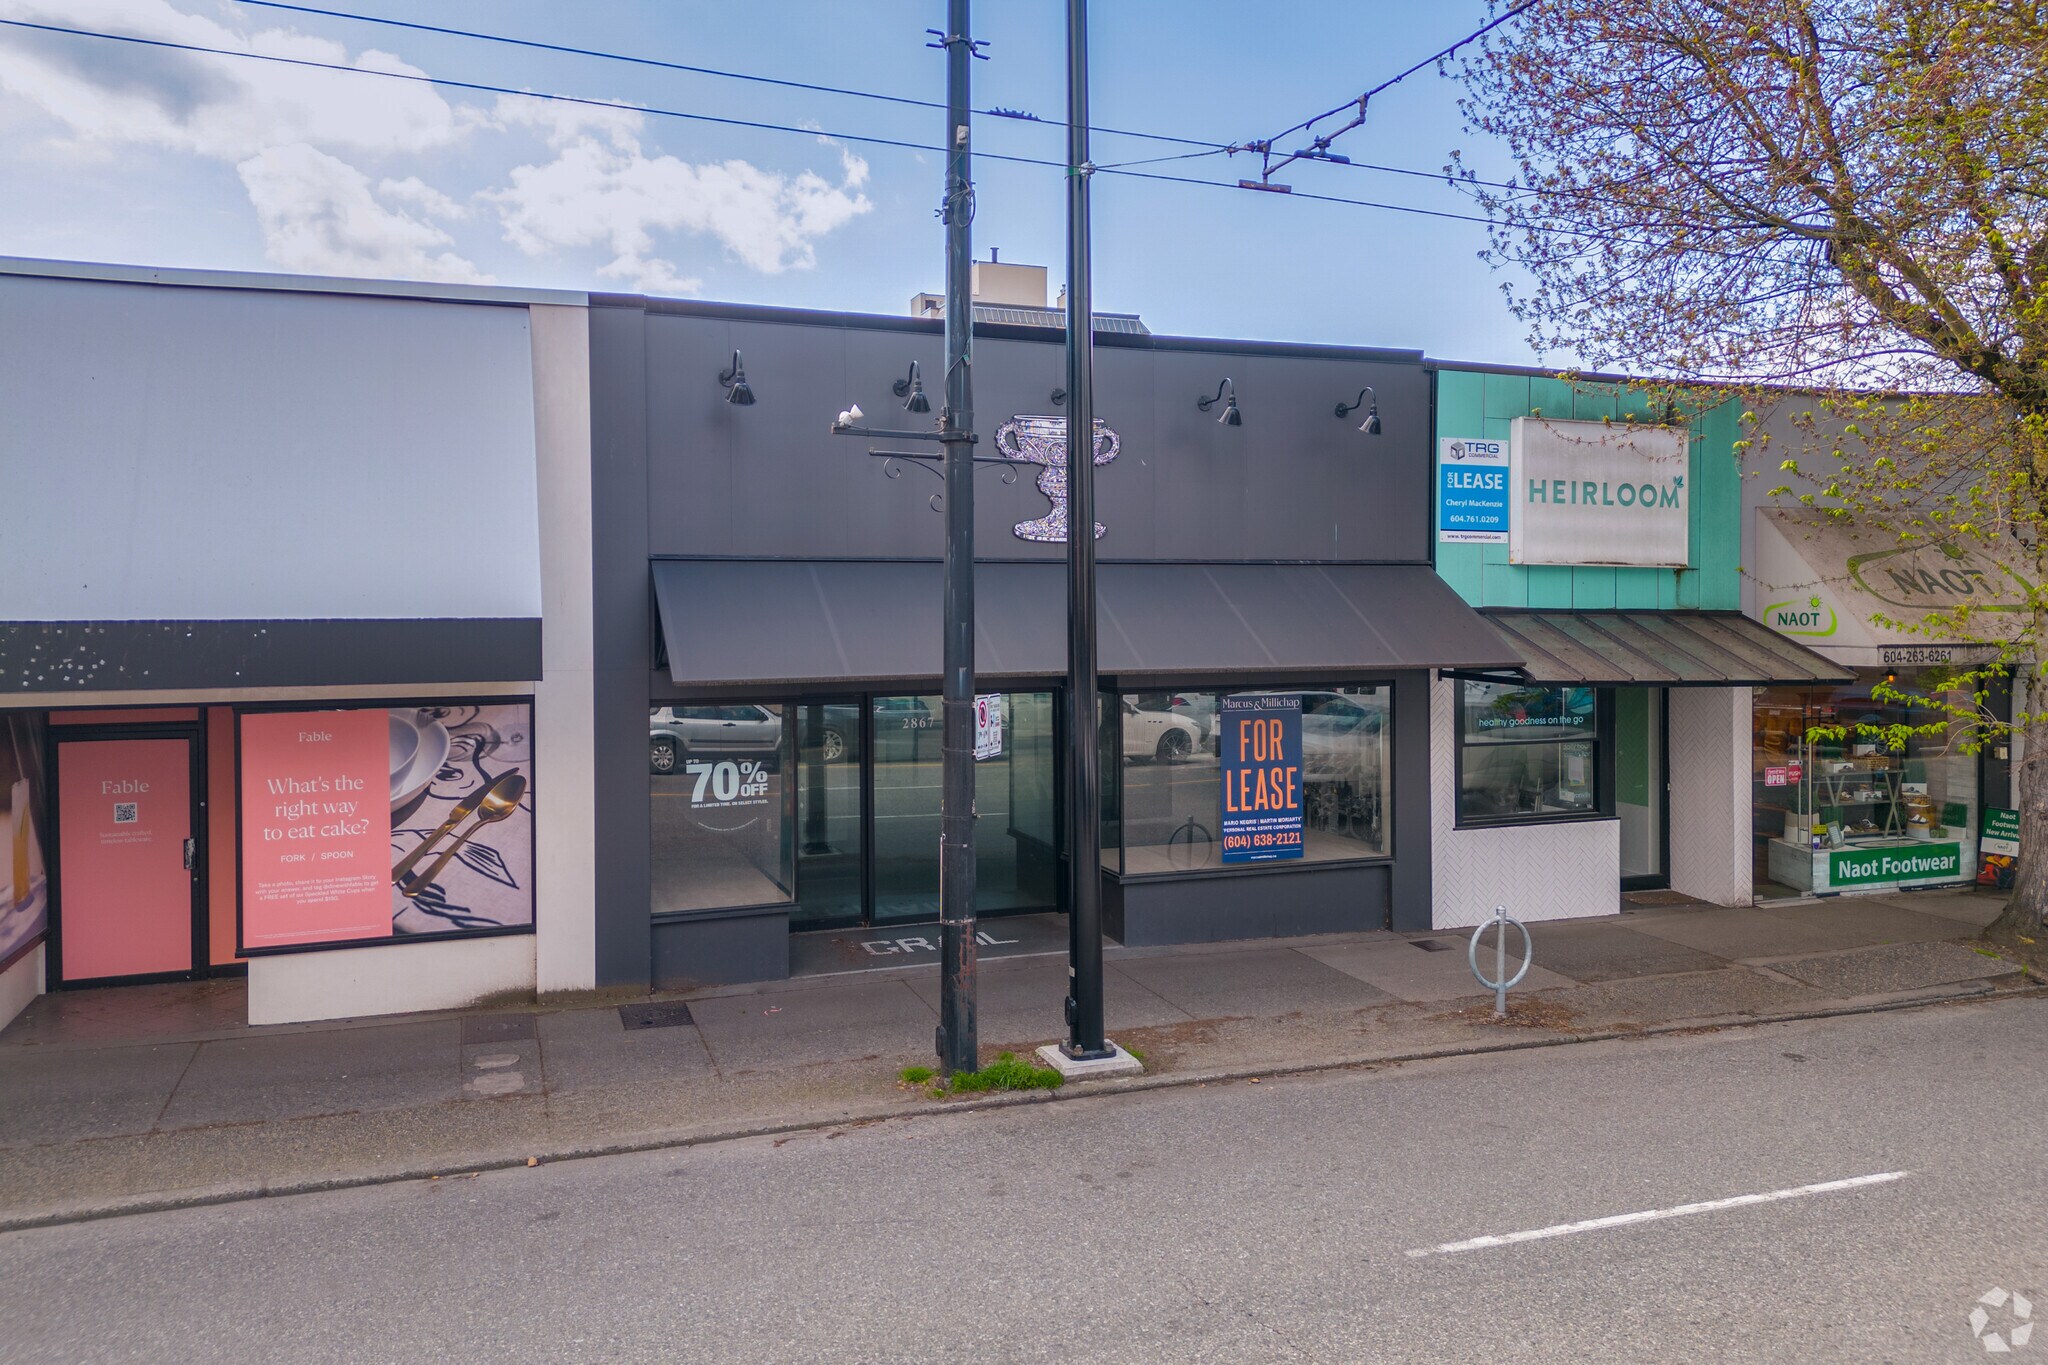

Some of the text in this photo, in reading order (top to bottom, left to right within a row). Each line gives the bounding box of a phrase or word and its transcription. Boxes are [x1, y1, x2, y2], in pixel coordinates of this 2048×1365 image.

[1465, 442, 1500, 454] TRG
[1454, 472, 1503, 490] LEASE
[1529, 478, 1680, 509] HEIRLOOM
[1446, 499, 1503, 508] Cheryl MacKenzie
[1450, 515, 1499, 523] 604.761.0209
[1888, 569, 1994, 595] NAOT
[1778, 612, 1820, 626] NAOT
[1883, 650, 1952, 663] 604-263-6261
[1222, 697, 1300, 710] Marcus & Millichap
[902, 717, 934, 729] 2867
[1478, 718, 1508, 727] healthy
[1509, 717, 1546, 728] goodness
[1560, 716, 1572, 724] the
[1573, 716, 1584, 725] go
[299, 732, 333, 742] Fable
[1240, 719, 1284, 762] FOR
[267, 774, 364, 795] What's the
[686, 761, 768, 803] 70%
[1768, 774, 1785, 784] OPEN
[102, 779, 150, 794] Fable
[740, 783, 768, 797] OFF
[1226, 766, 1298, 812] LEASE
[275, 800, 358, 820] right way
[2000, 812, 2016, 820] Naot
[264, 818, 370, 840] to eat cake?
[1986, 828, 2000, 836] New
[1992, 820, 2019, 830] Footwea
[1224, 832, 1302, 850] (604) 638-2121
[280, 854, 306, 862] FORK
[320, 850, 354, 860] SPOON
[1838, 855, 1956, 878] Naot Footwear
[861, 932, 1019, 956] GRIL
